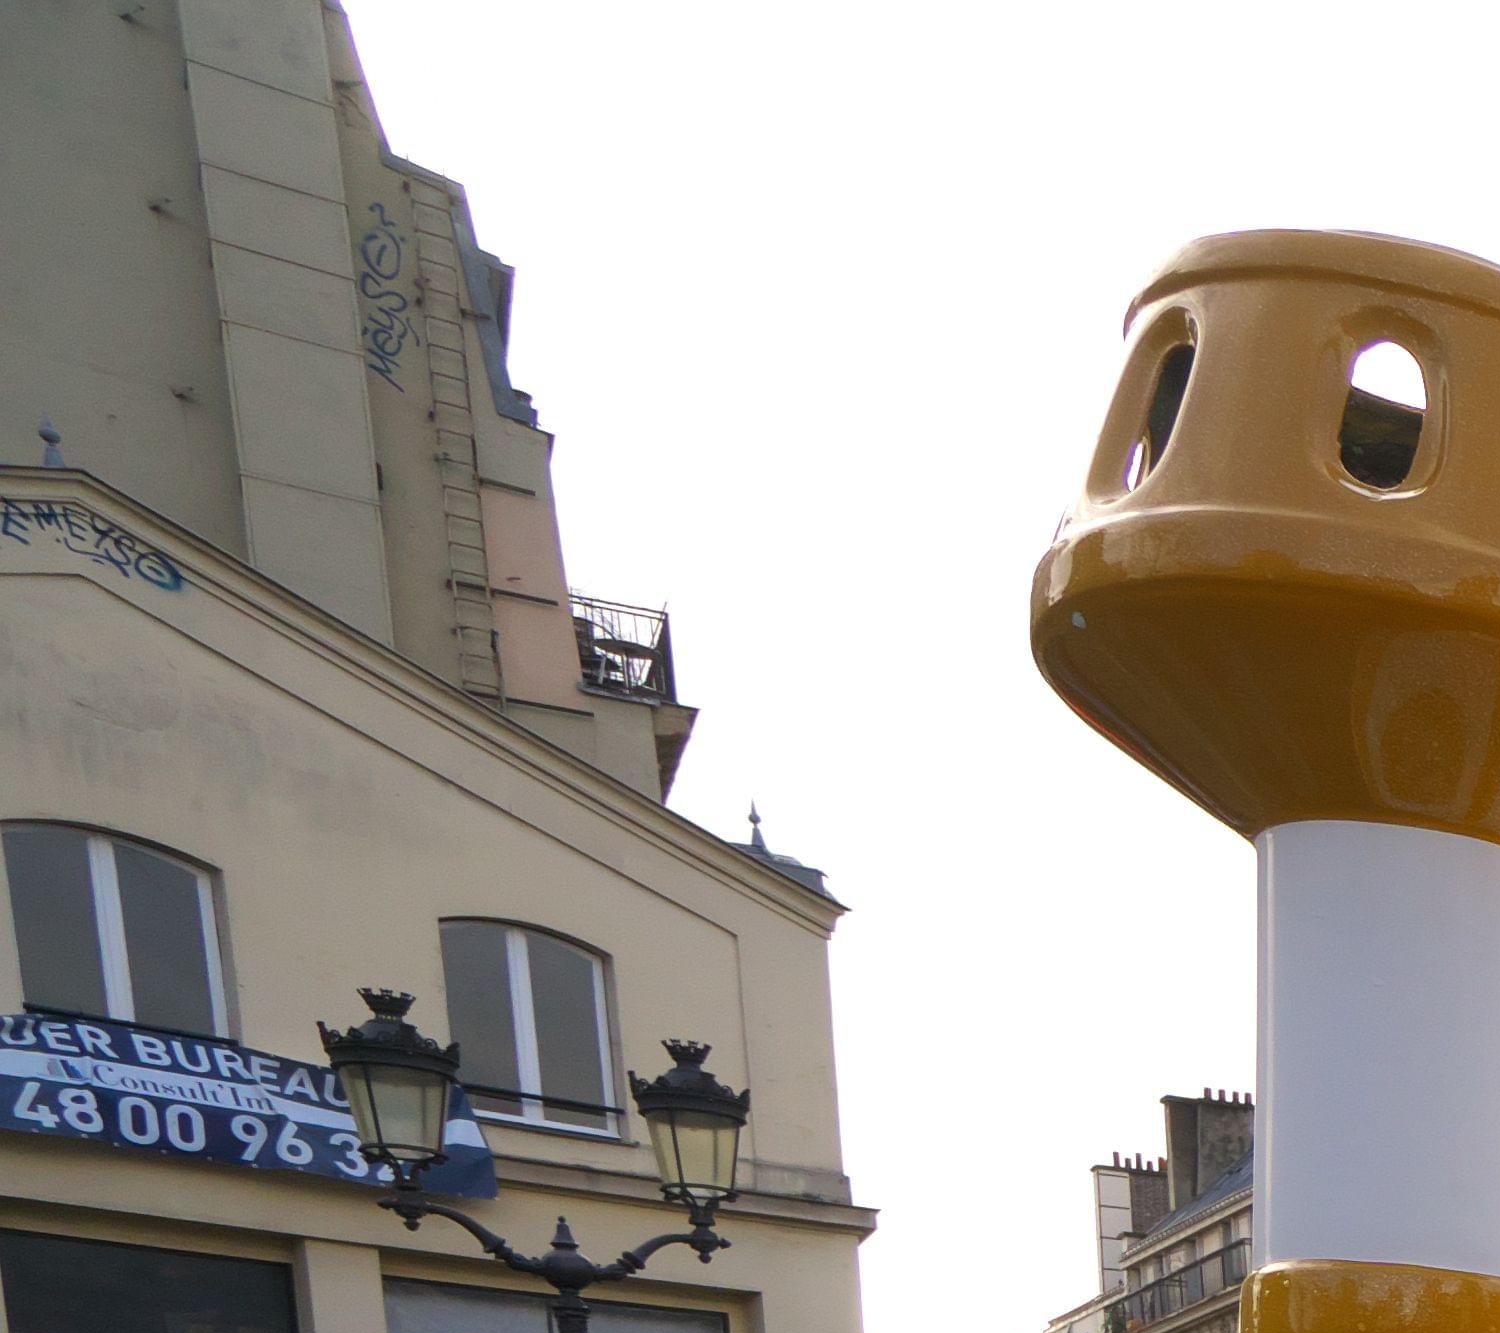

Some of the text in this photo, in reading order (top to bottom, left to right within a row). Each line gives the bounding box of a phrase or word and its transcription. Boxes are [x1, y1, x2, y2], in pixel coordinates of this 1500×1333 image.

[13, 1081, 104, 1133] 48
[117, 1096, 207, 1153] 00
[230, 1114, 314, 1166] 96
